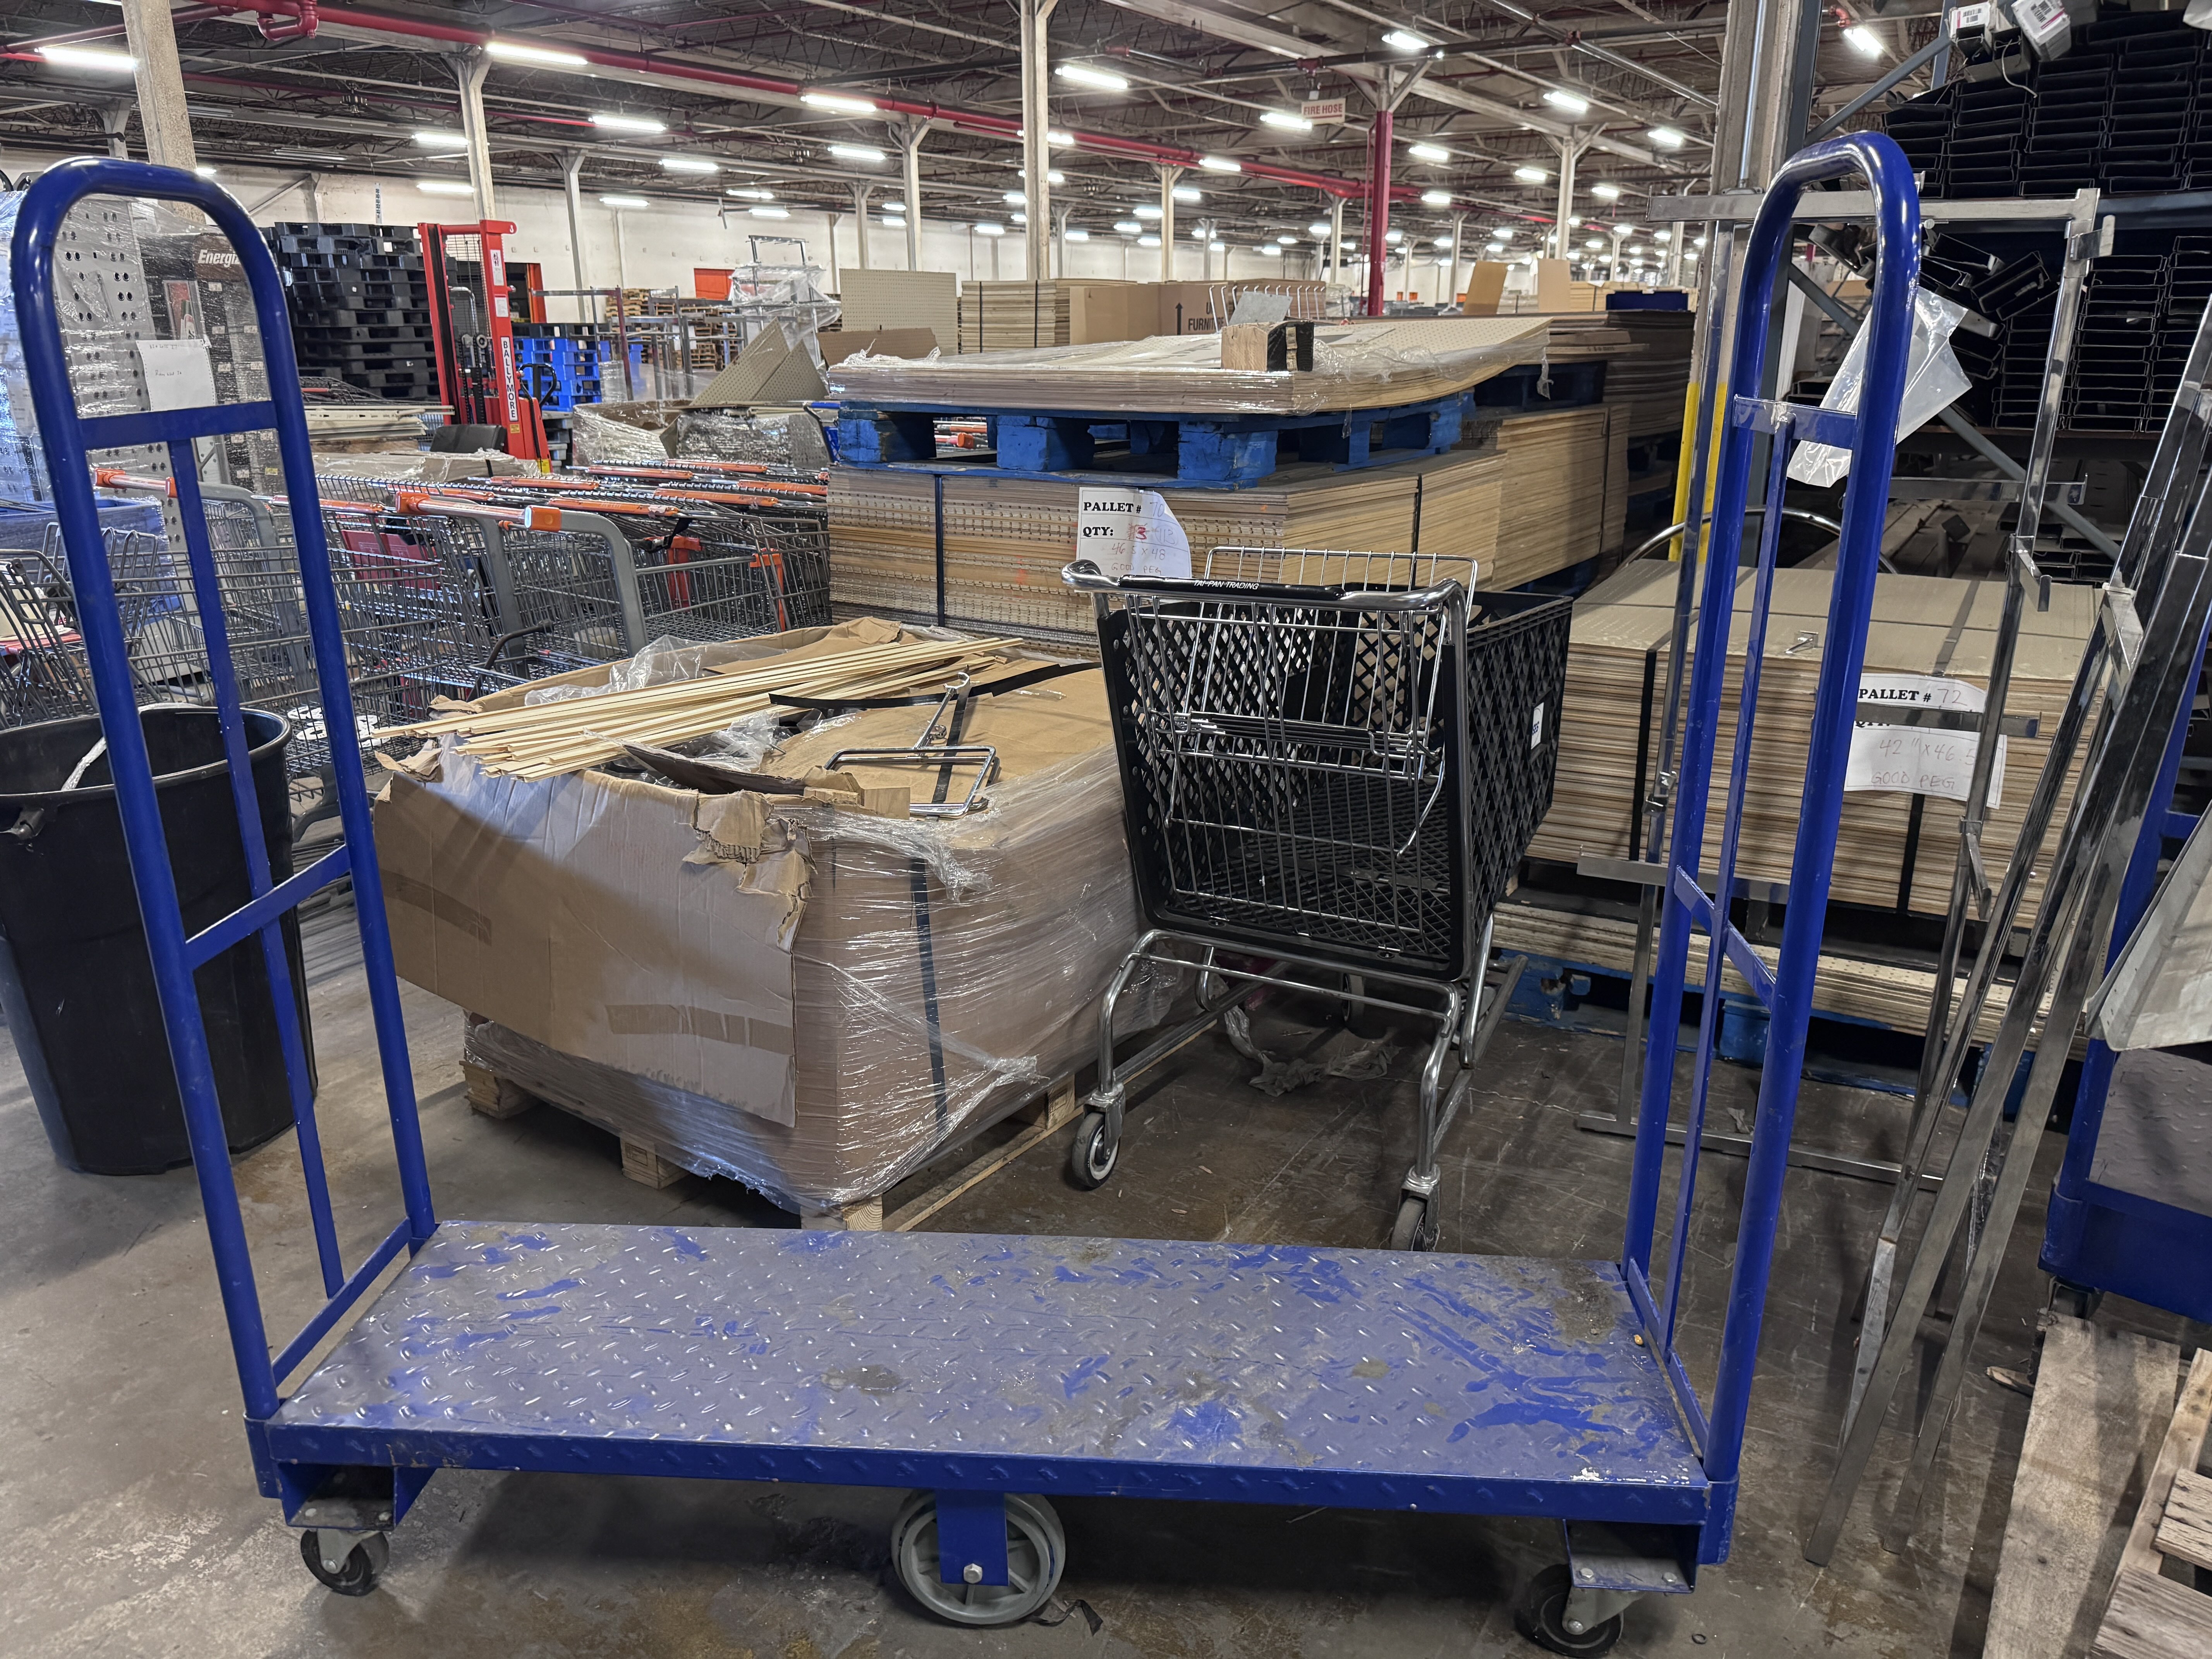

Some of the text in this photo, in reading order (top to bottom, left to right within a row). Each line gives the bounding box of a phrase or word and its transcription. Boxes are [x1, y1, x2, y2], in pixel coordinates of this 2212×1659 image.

[1304, 103, 1343, 115] FIRE HOSE
[503, 341, 516, 418] BALLYMORE
[1084, 501, 1165, 517] PALLET # 70
[1083, 526, 1114, 538] QTY:
[1152, 548, 1166, 560] 48
[1111, 563, 1161, 575] GOOD PEG
[1226, 581, 1259, 590] TRADING
[1858, 689, 1968, 706] PALLET # 72
[1871, 771, 1955, 790] GOOD PEG
